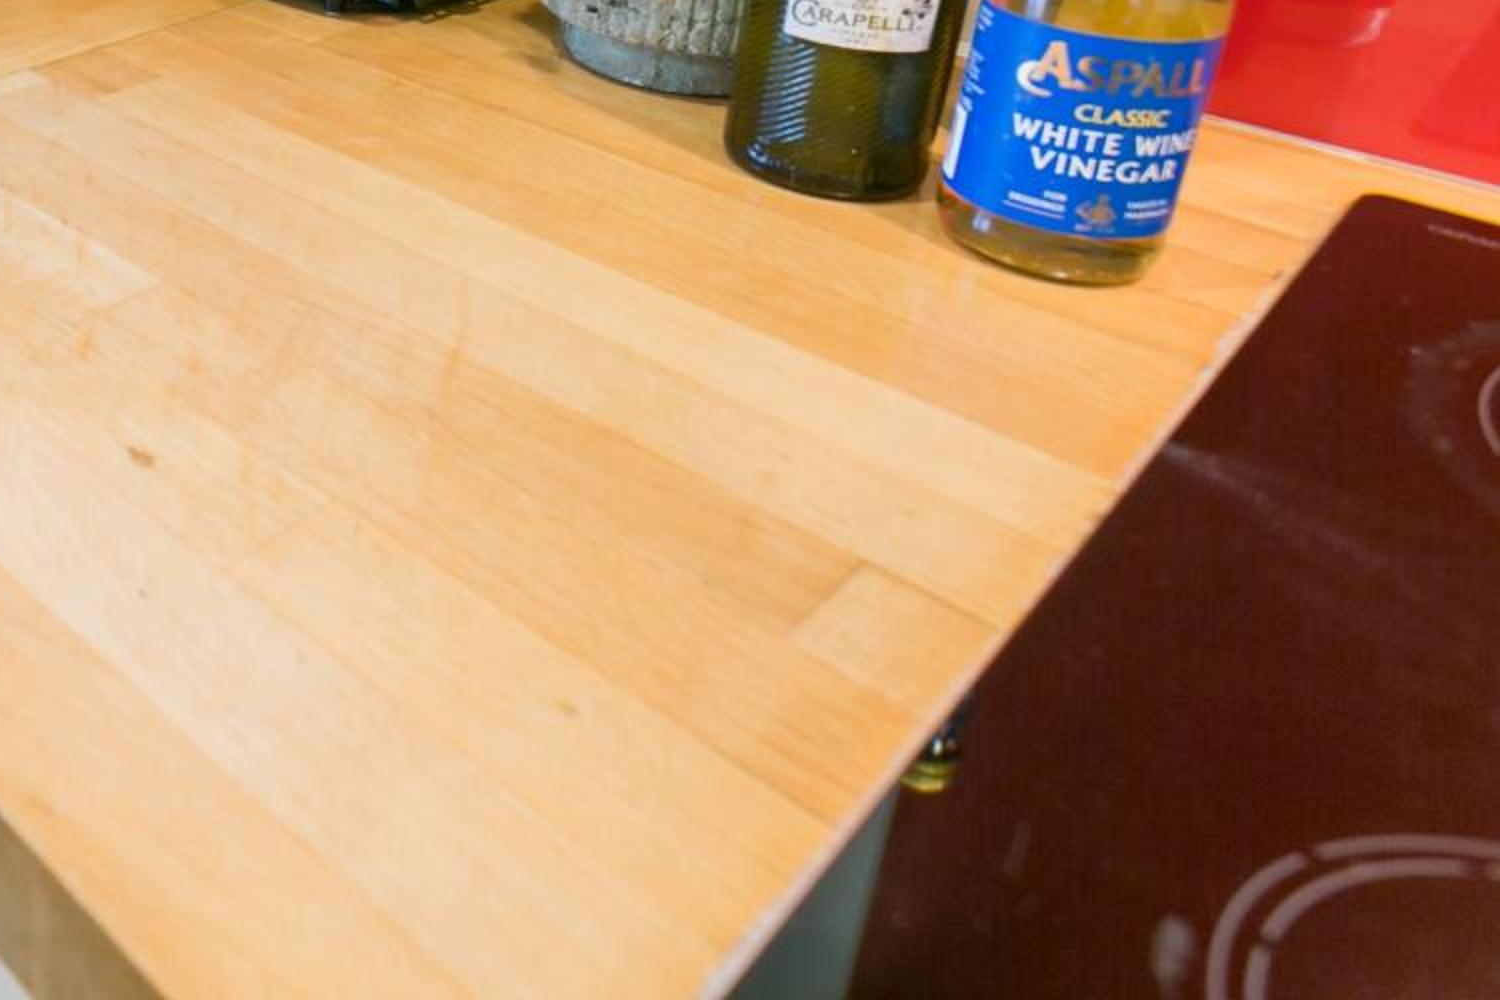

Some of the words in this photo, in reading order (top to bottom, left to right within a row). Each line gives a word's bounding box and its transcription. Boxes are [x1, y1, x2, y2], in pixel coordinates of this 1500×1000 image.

[1016, 40, 1205, 97] ASPALL
[1012, 111, 1124, 156] WHITE
[1074, 104, 1171, 128] CLASSIC
[1029, 145, 1178, 184] VINEGAR
